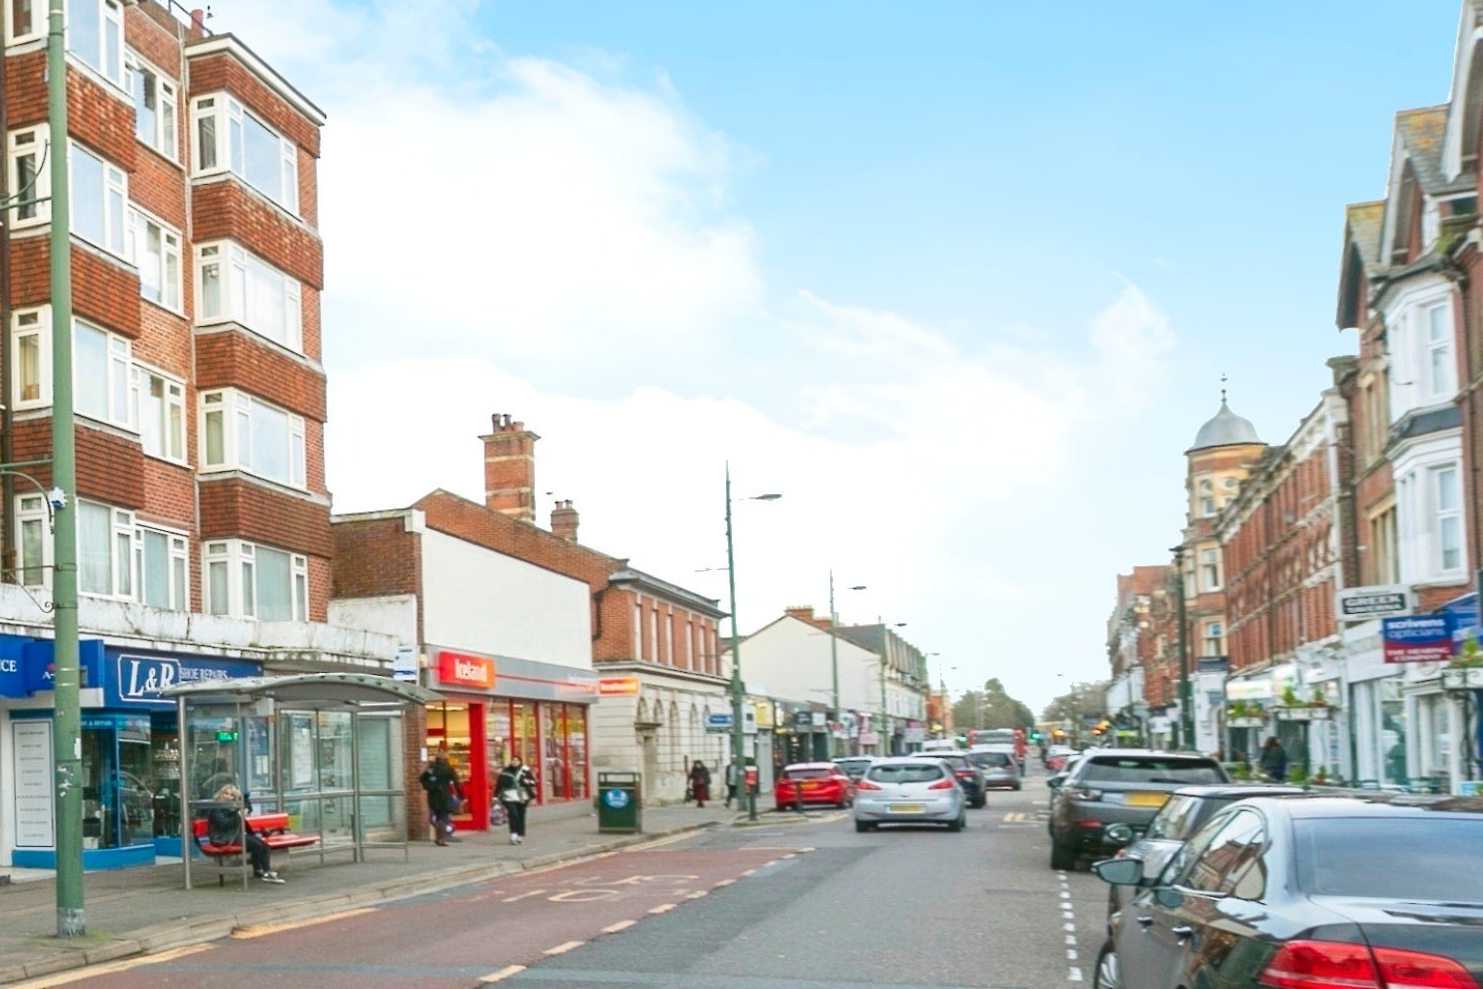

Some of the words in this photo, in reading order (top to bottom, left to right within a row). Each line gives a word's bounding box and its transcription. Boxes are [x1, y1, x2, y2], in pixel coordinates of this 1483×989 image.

[1387, 619, 1446, 629] scrivens
[180, 667, 200, 680] SHOE
[454, 659, 488, 682] Iceland
